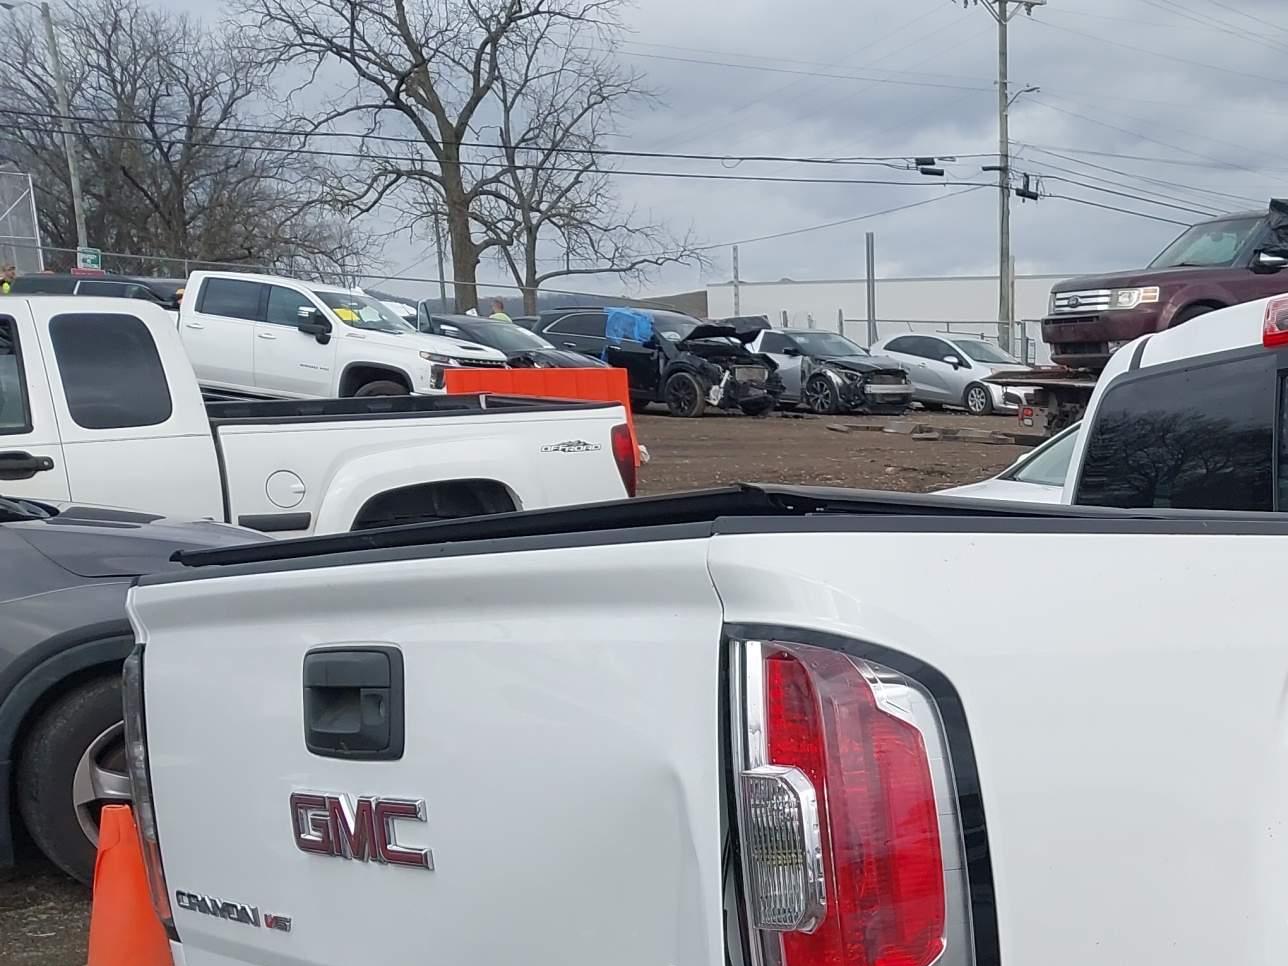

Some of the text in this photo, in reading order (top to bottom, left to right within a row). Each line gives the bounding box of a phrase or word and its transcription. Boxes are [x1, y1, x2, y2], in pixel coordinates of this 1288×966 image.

[290, 791, 435, 871] GMC
[176, 890, 292, 933] CANYON V6
